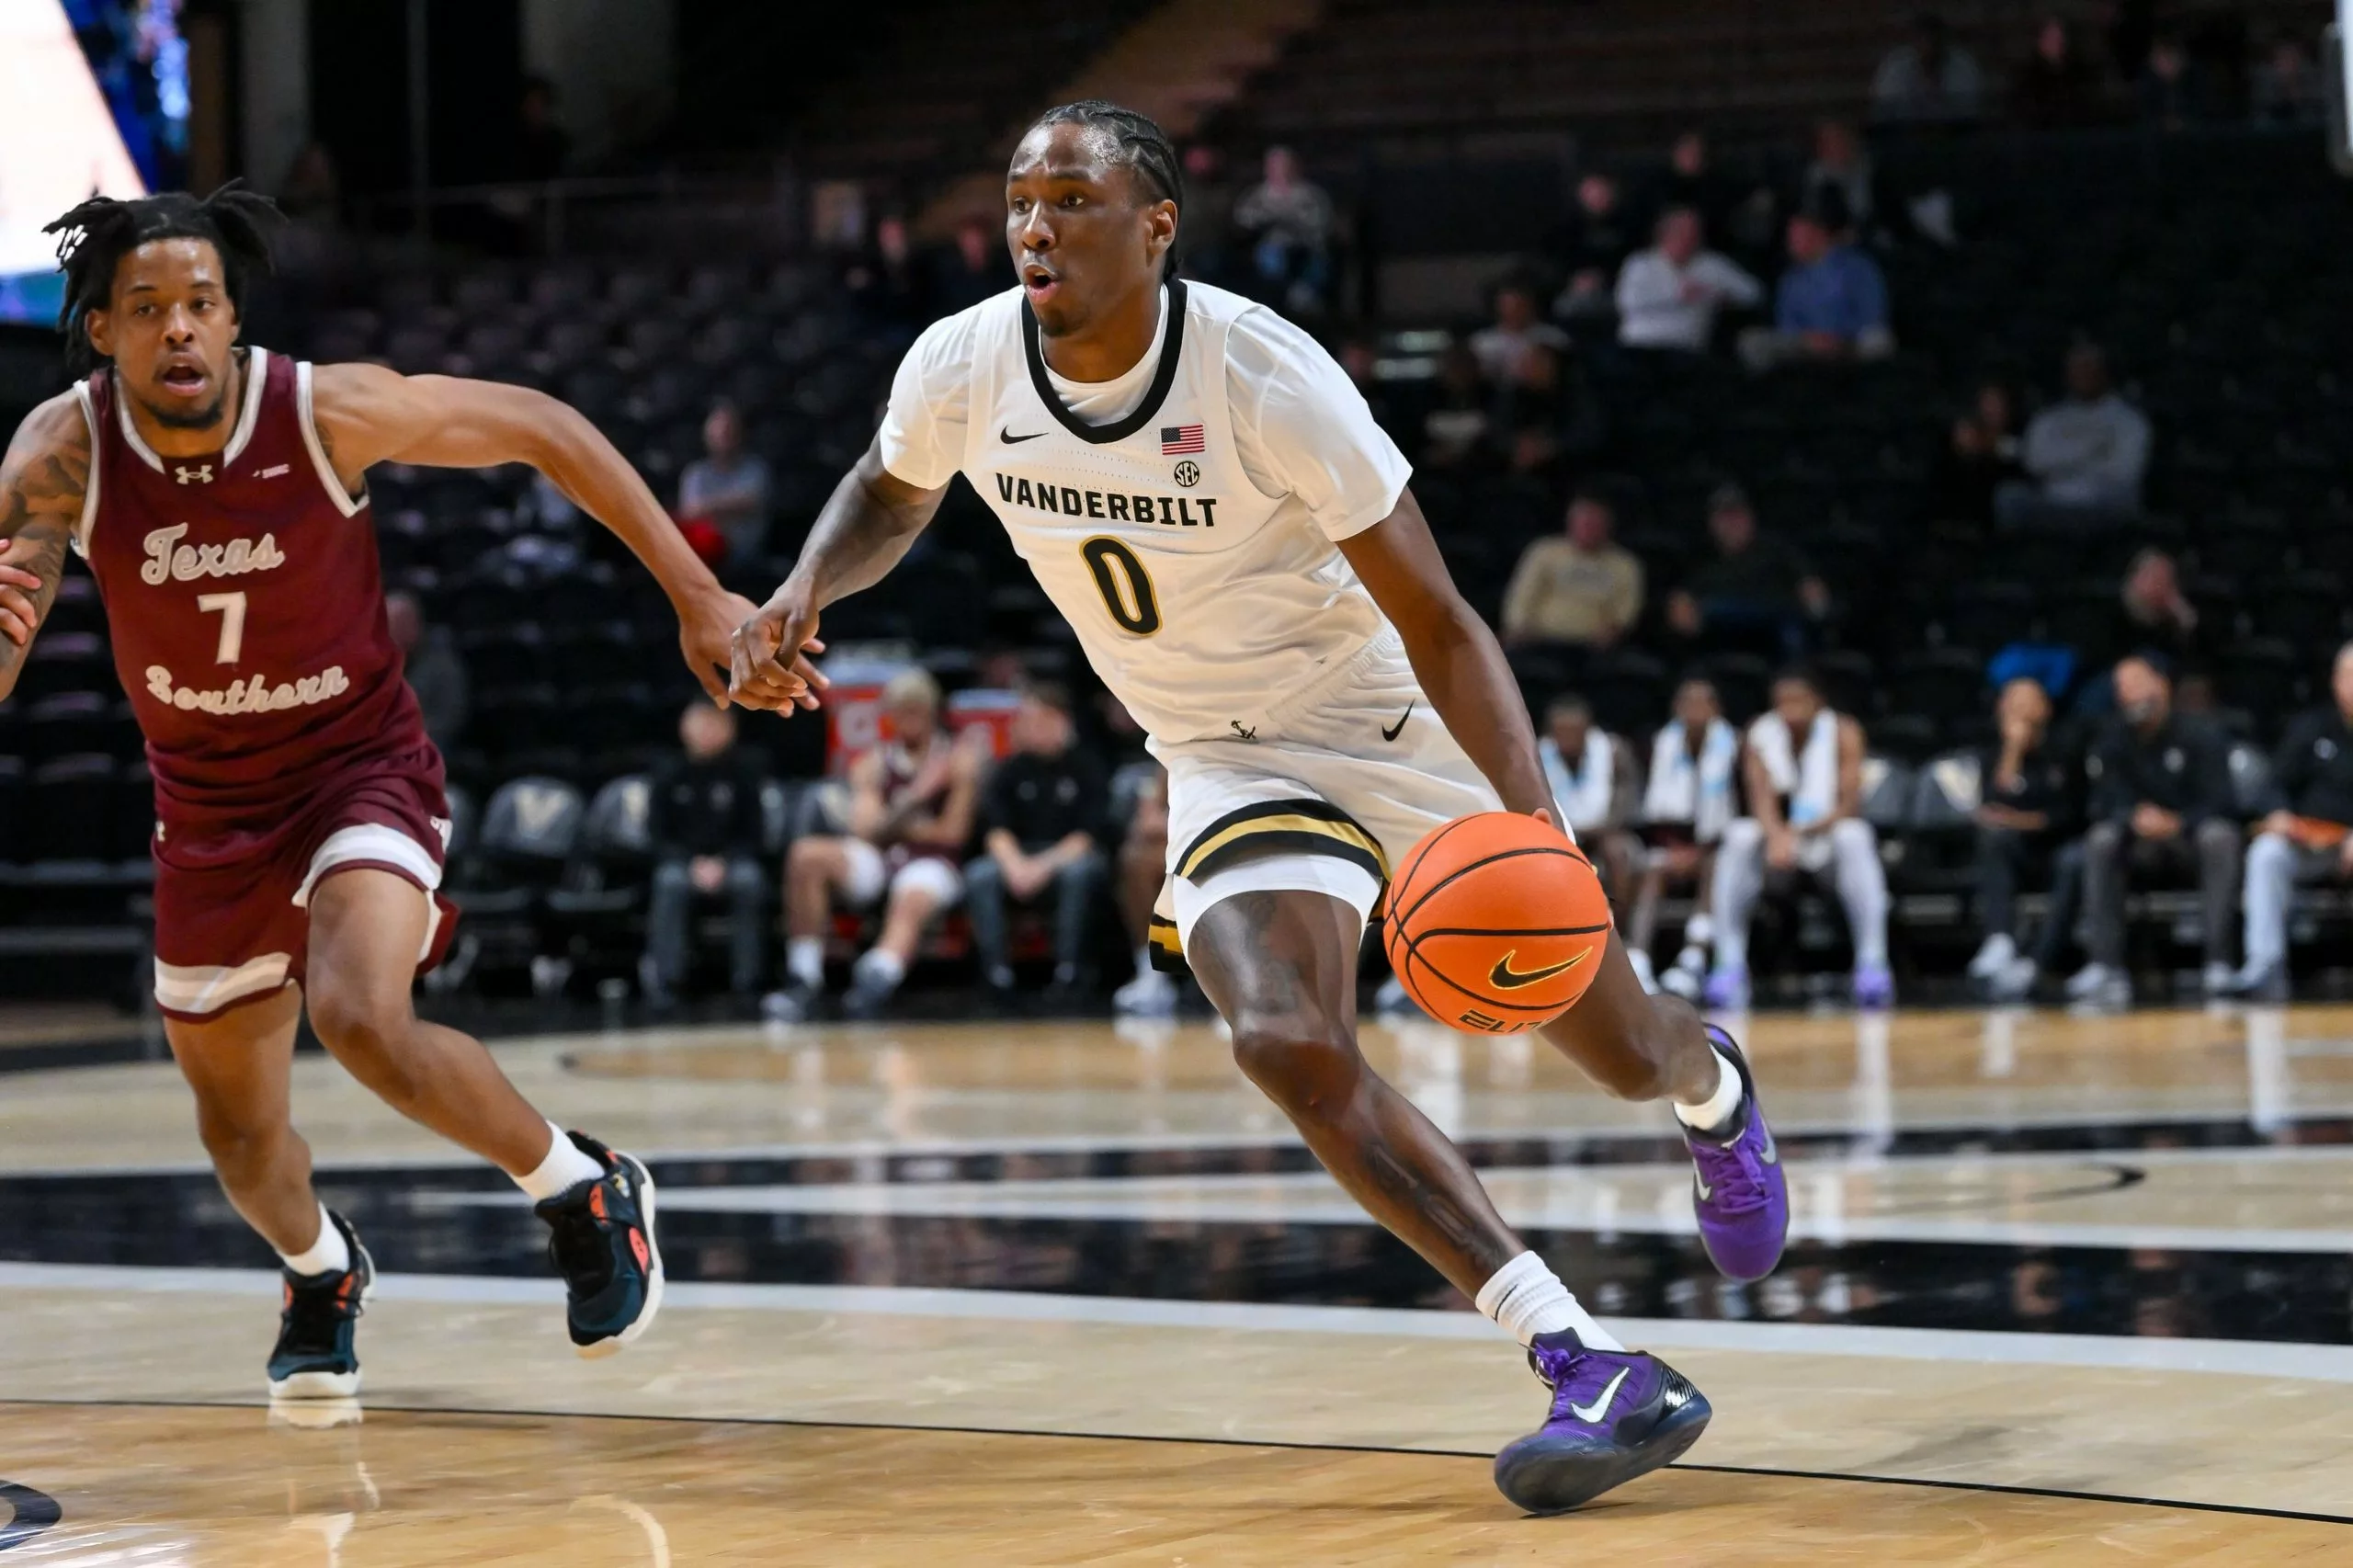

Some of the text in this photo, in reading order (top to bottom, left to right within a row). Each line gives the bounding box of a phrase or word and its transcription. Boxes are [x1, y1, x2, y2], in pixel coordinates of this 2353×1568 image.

[995, 472, 1217, 527] VANDERBILT
[1175, 461, 1199, 486] SEC
[141, 522, 286, 585] Texas
[1079, 535, 1163, 637] 0
[197, 591, 246, 665] 7
[145, 665, 349, 715] Southern
